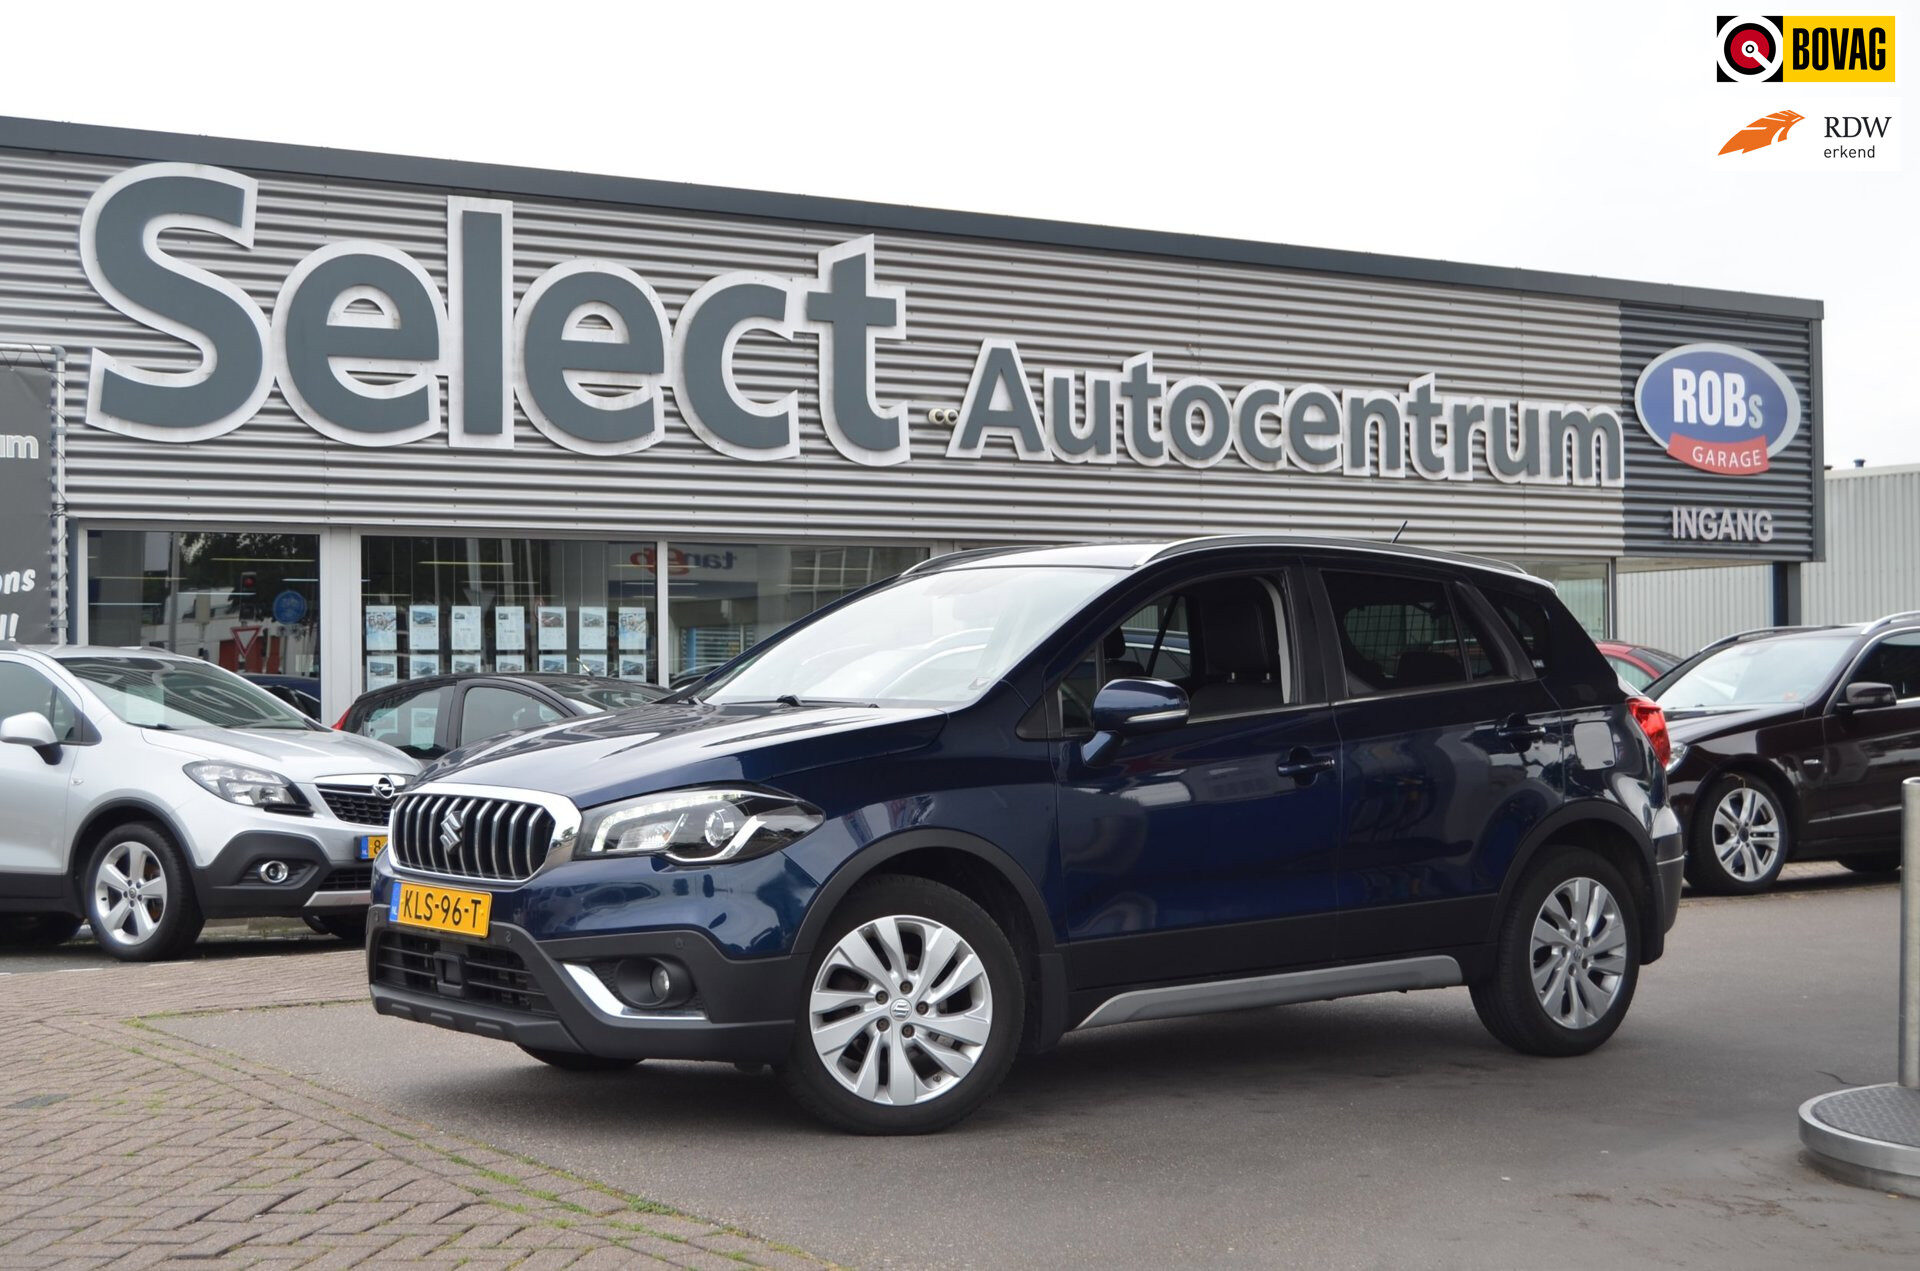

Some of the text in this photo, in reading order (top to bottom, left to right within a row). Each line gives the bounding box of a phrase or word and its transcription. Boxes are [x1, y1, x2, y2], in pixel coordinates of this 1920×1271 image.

[80, 163, 1625, 488] Select Autocentrum
[1672, 368, 1763, 429] ROBs
[1692, 446, 1762, 468] GARAGE
[1672, 507, 1773, 542] INGANG
[0, 568, 36, 595] ns
[403, 890, 481, 928] KLS-96-T
